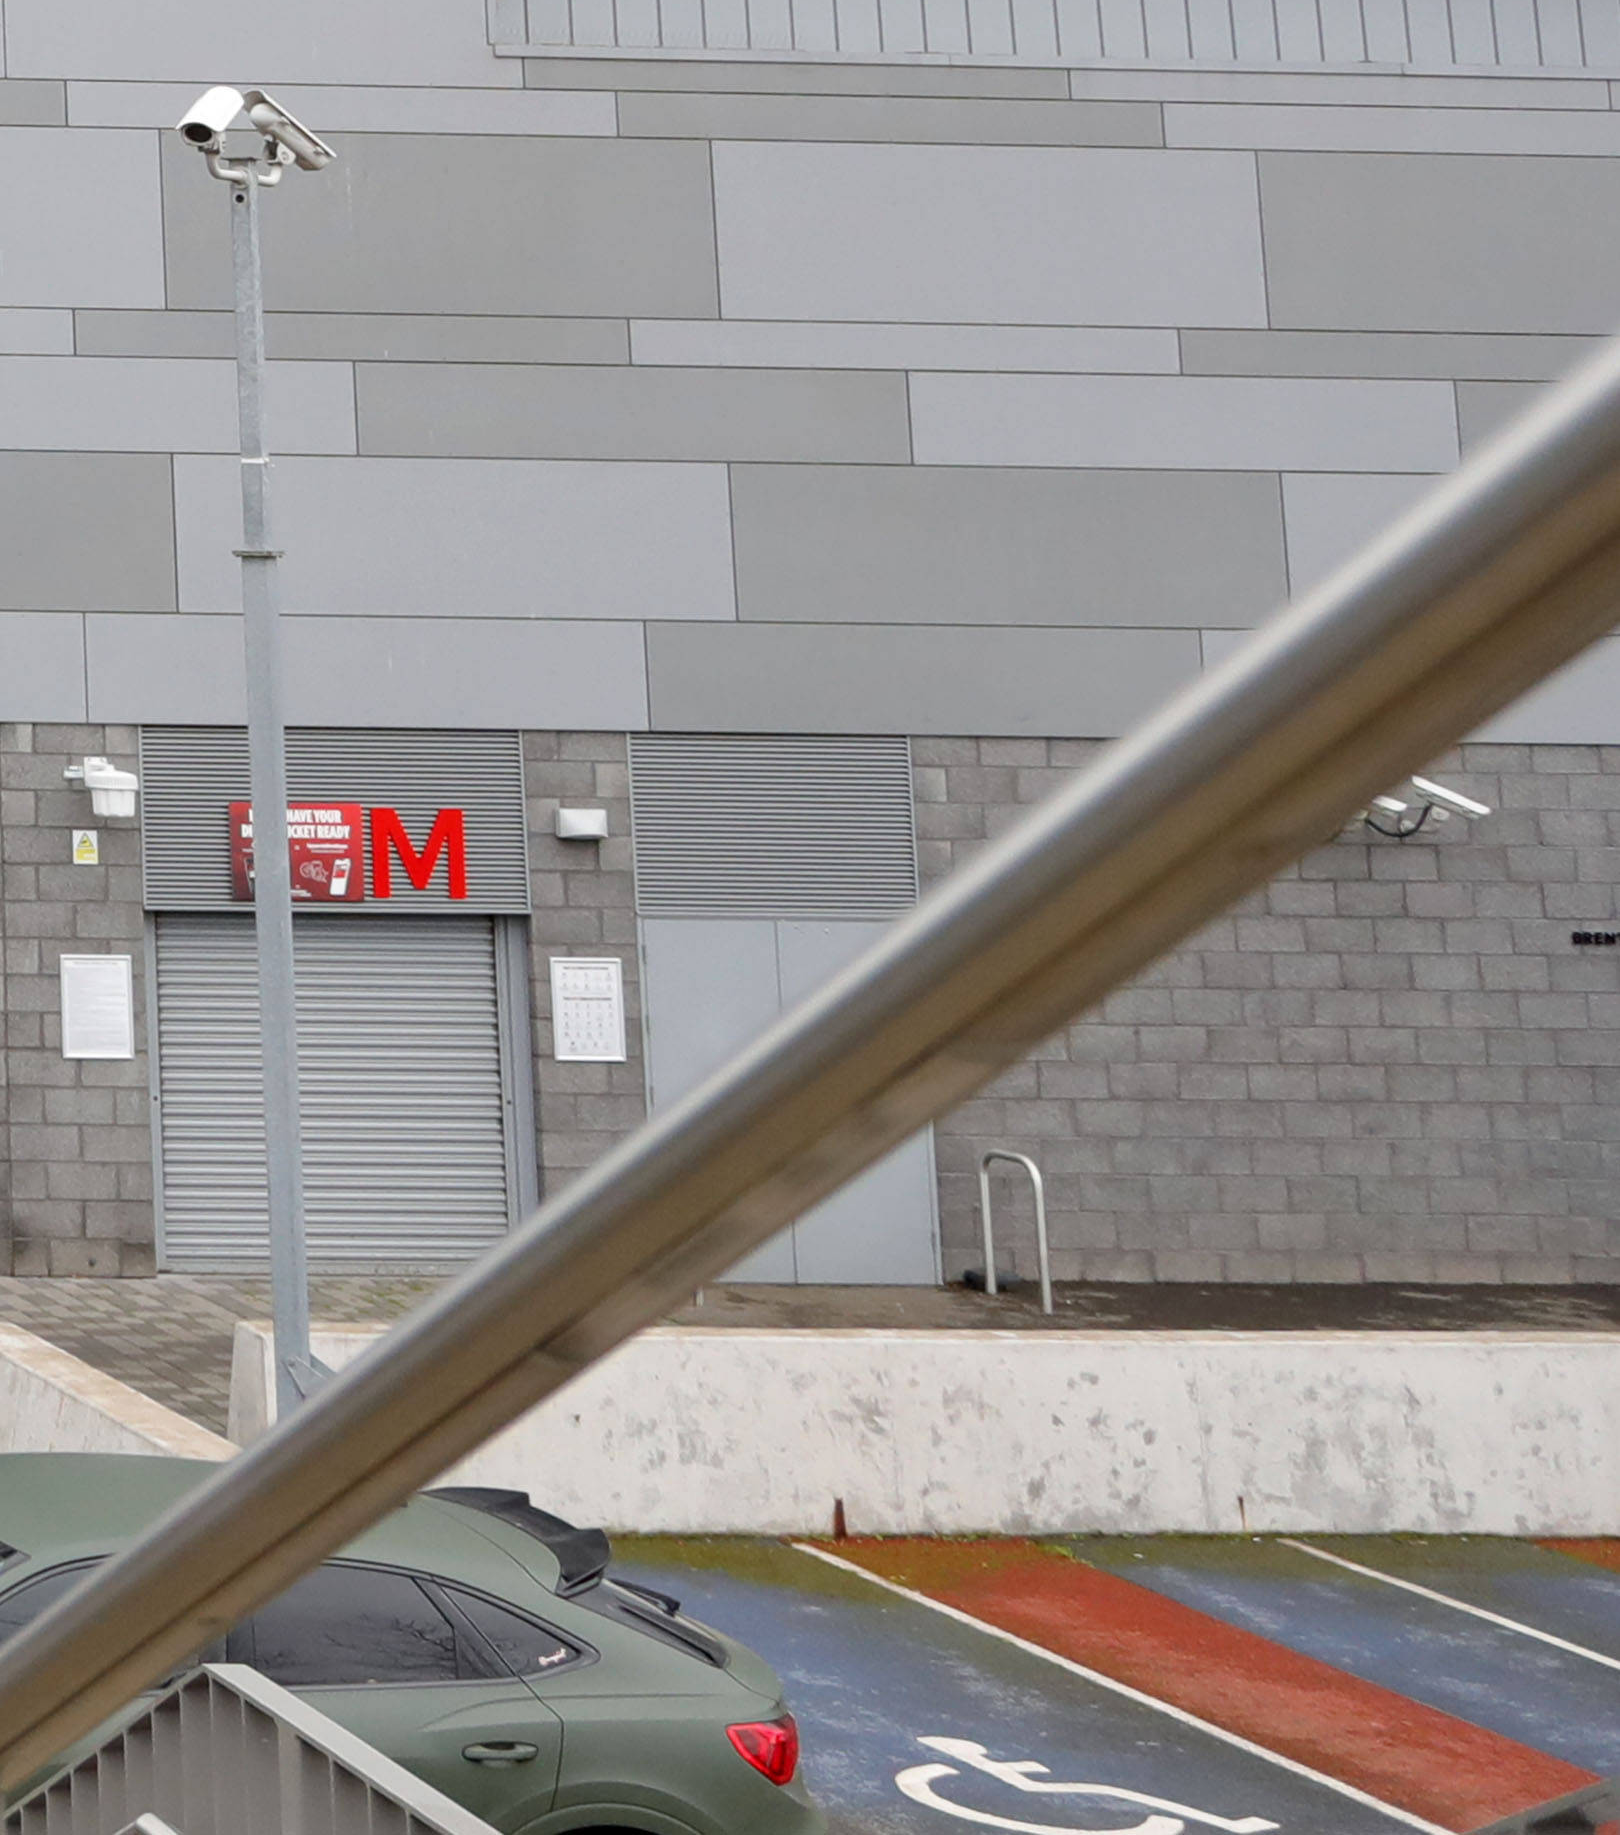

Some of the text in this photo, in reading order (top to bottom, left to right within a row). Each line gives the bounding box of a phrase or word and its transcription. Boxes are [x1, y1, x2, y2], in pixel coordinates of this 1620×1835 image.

[287, 809, 342, 823] HAVE YOUR
[287, 825, 351, 839] ICKET READY
[370, 807, 468, 900] M
